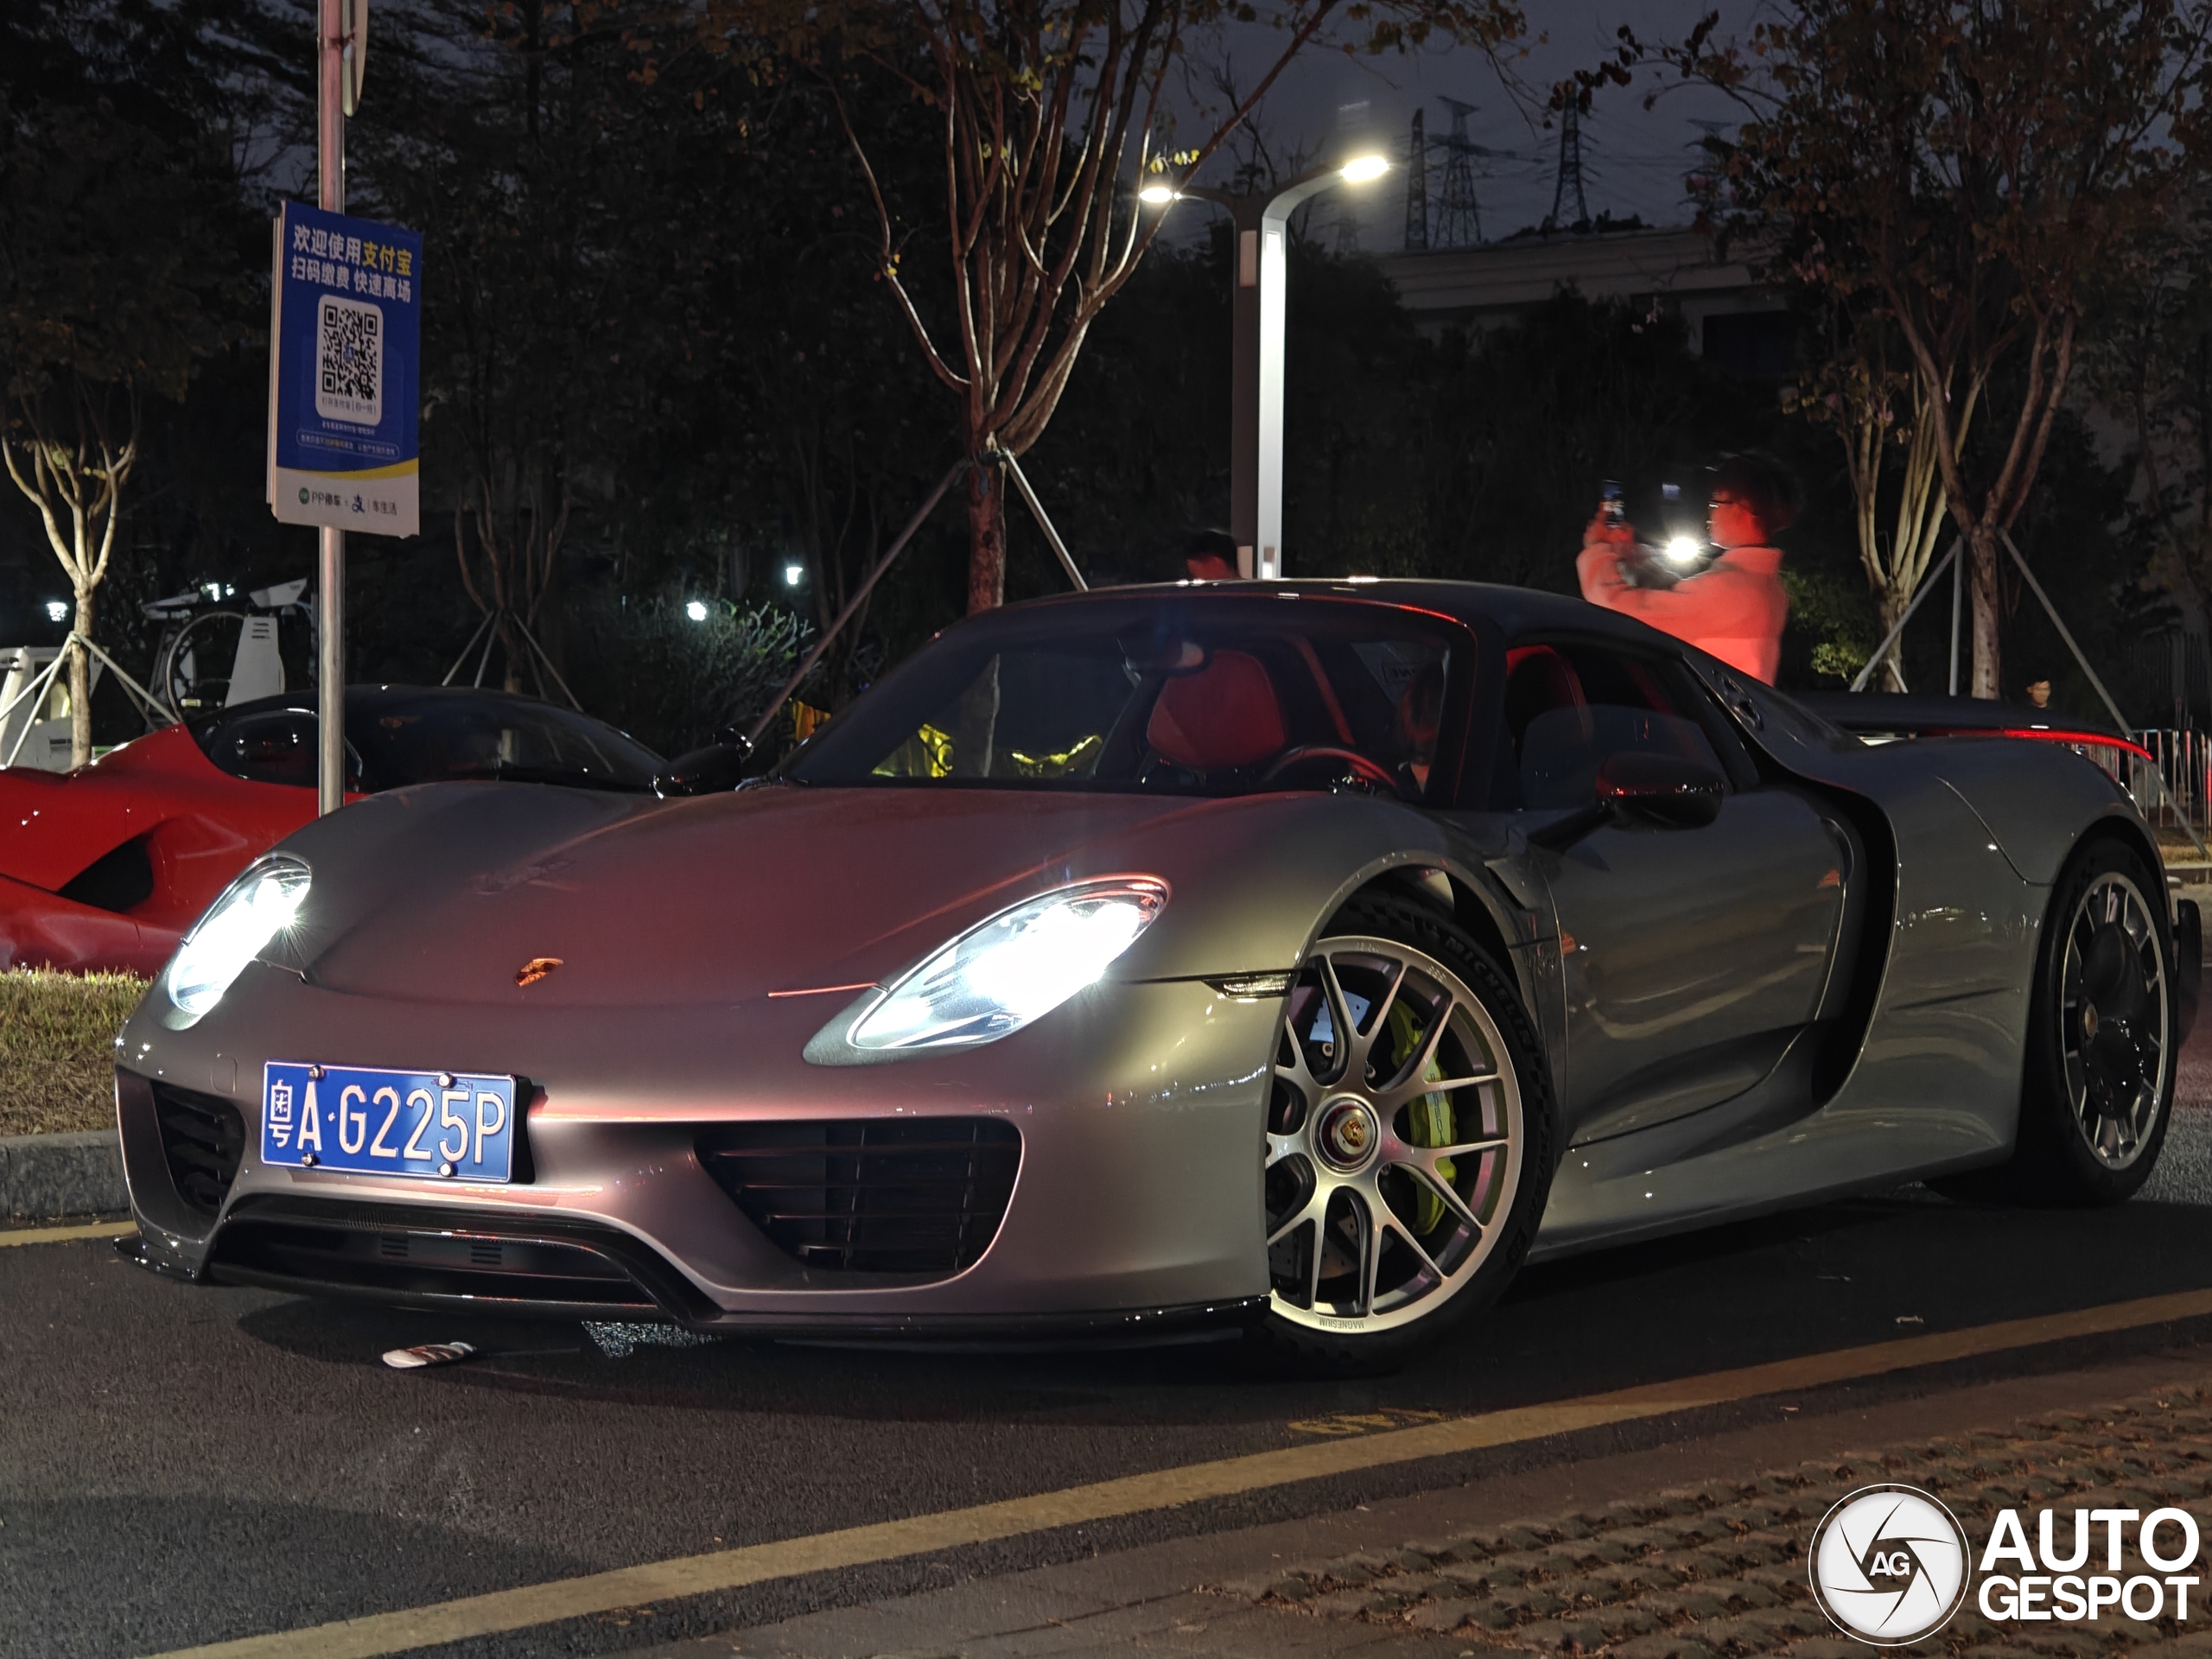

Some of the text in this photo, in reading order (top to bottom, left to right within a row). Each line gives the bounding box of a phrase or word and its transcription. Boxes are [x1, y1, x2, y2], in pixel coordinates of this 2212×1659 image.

[293, 224, 412, 276] 欢迎使用支付宝
[292, 254, 410, 303] 扫码缴费 快速离场
[1319, 1317, 1364, 1330] MAGNESIUM
